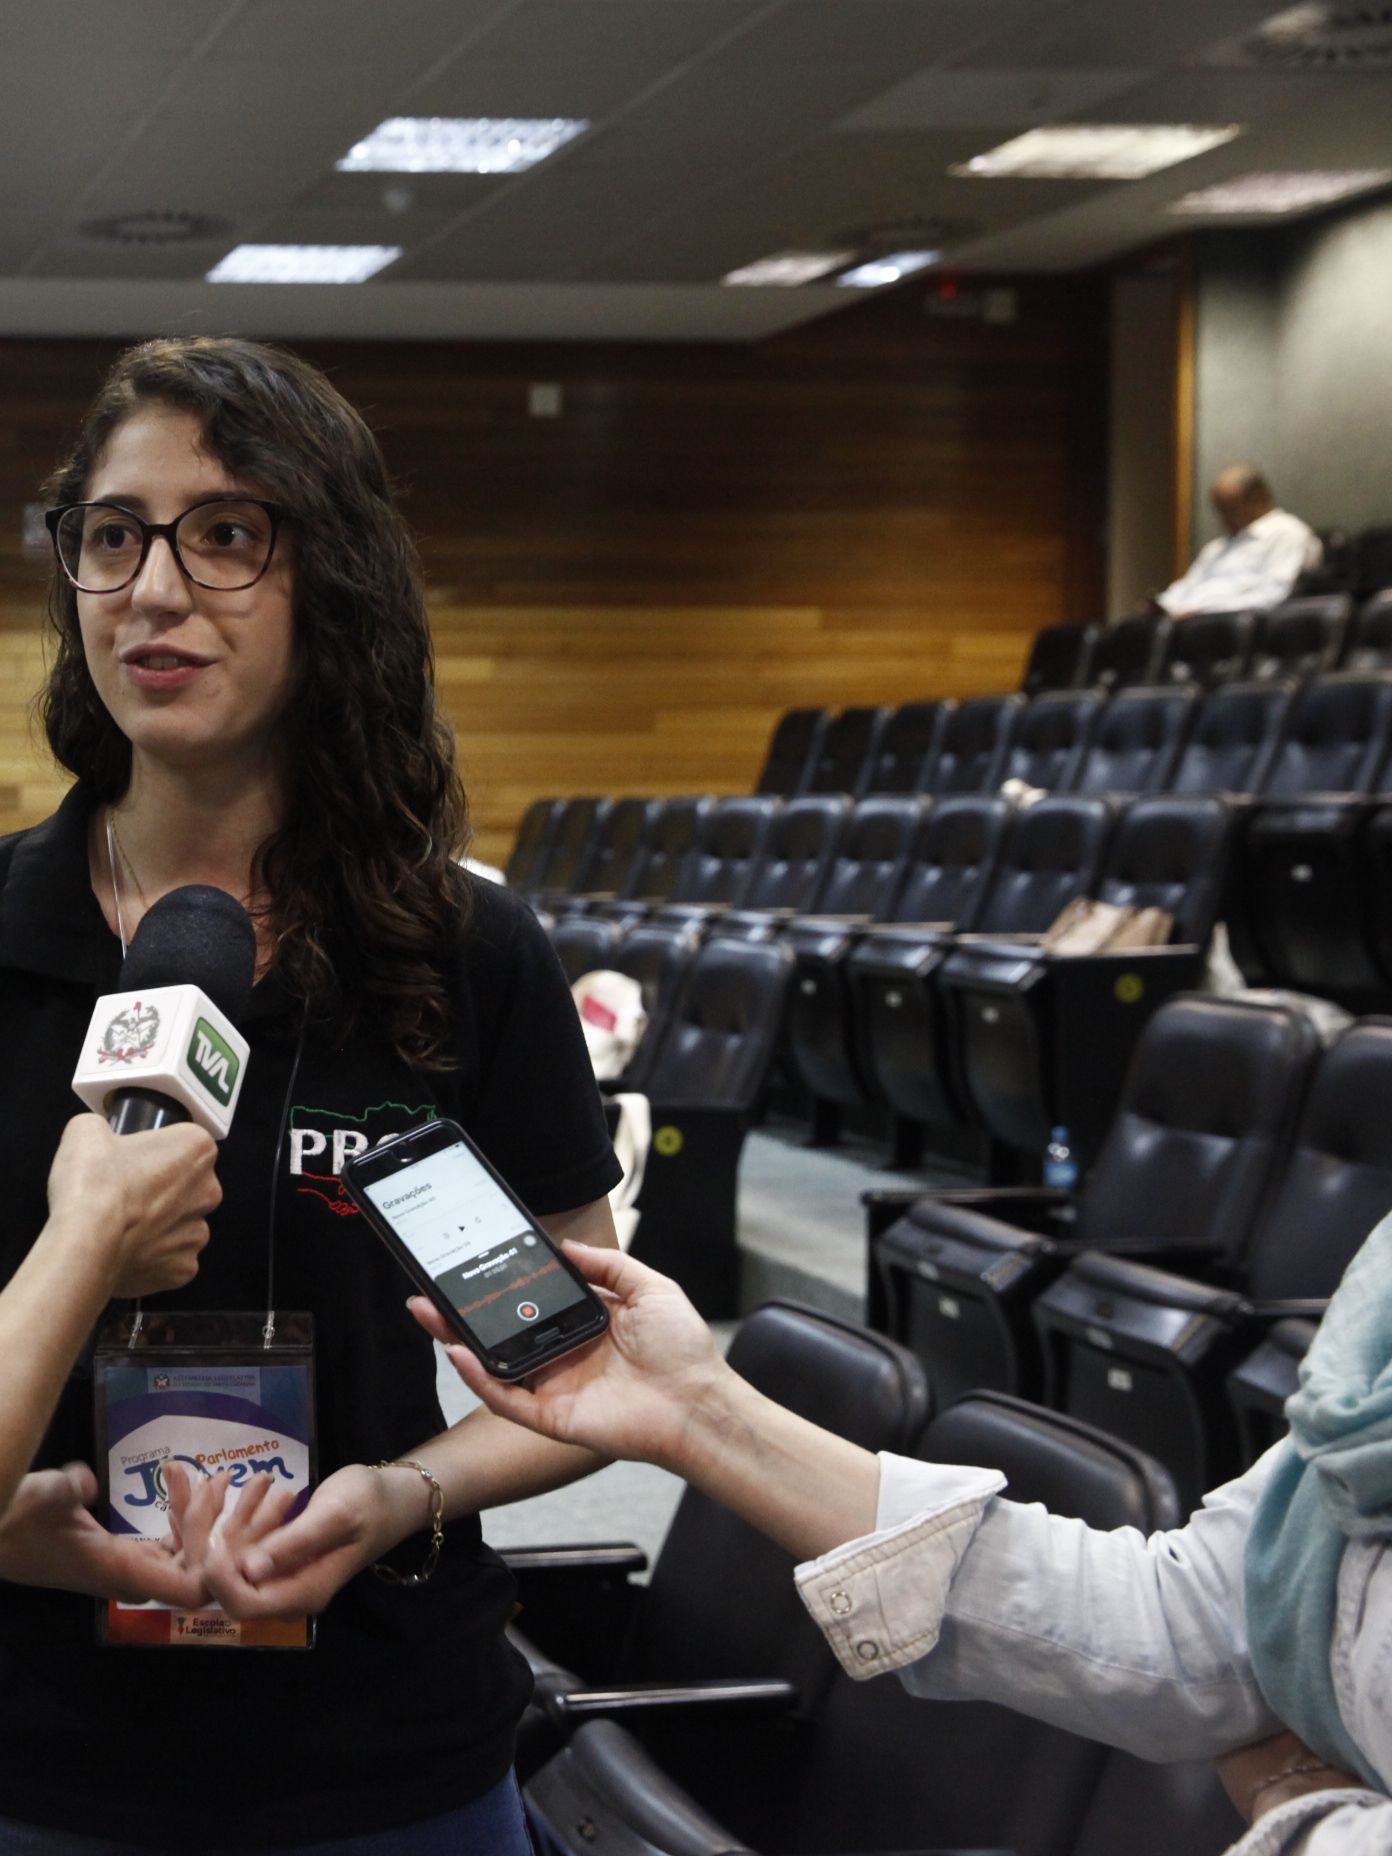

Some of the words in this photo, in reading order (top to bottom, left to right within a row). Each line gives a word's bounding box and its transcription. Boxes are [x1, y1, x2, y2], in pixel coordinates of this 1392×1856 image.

[382, 1182, 432, 1210] Gravações
[120, 1445, 171, 1466] Programa
[195, 1439, 280, 1466] Parlamento
[185, 1626, 237, 1637] Legislativo
[193, 1618, 224, 1627] Escola
